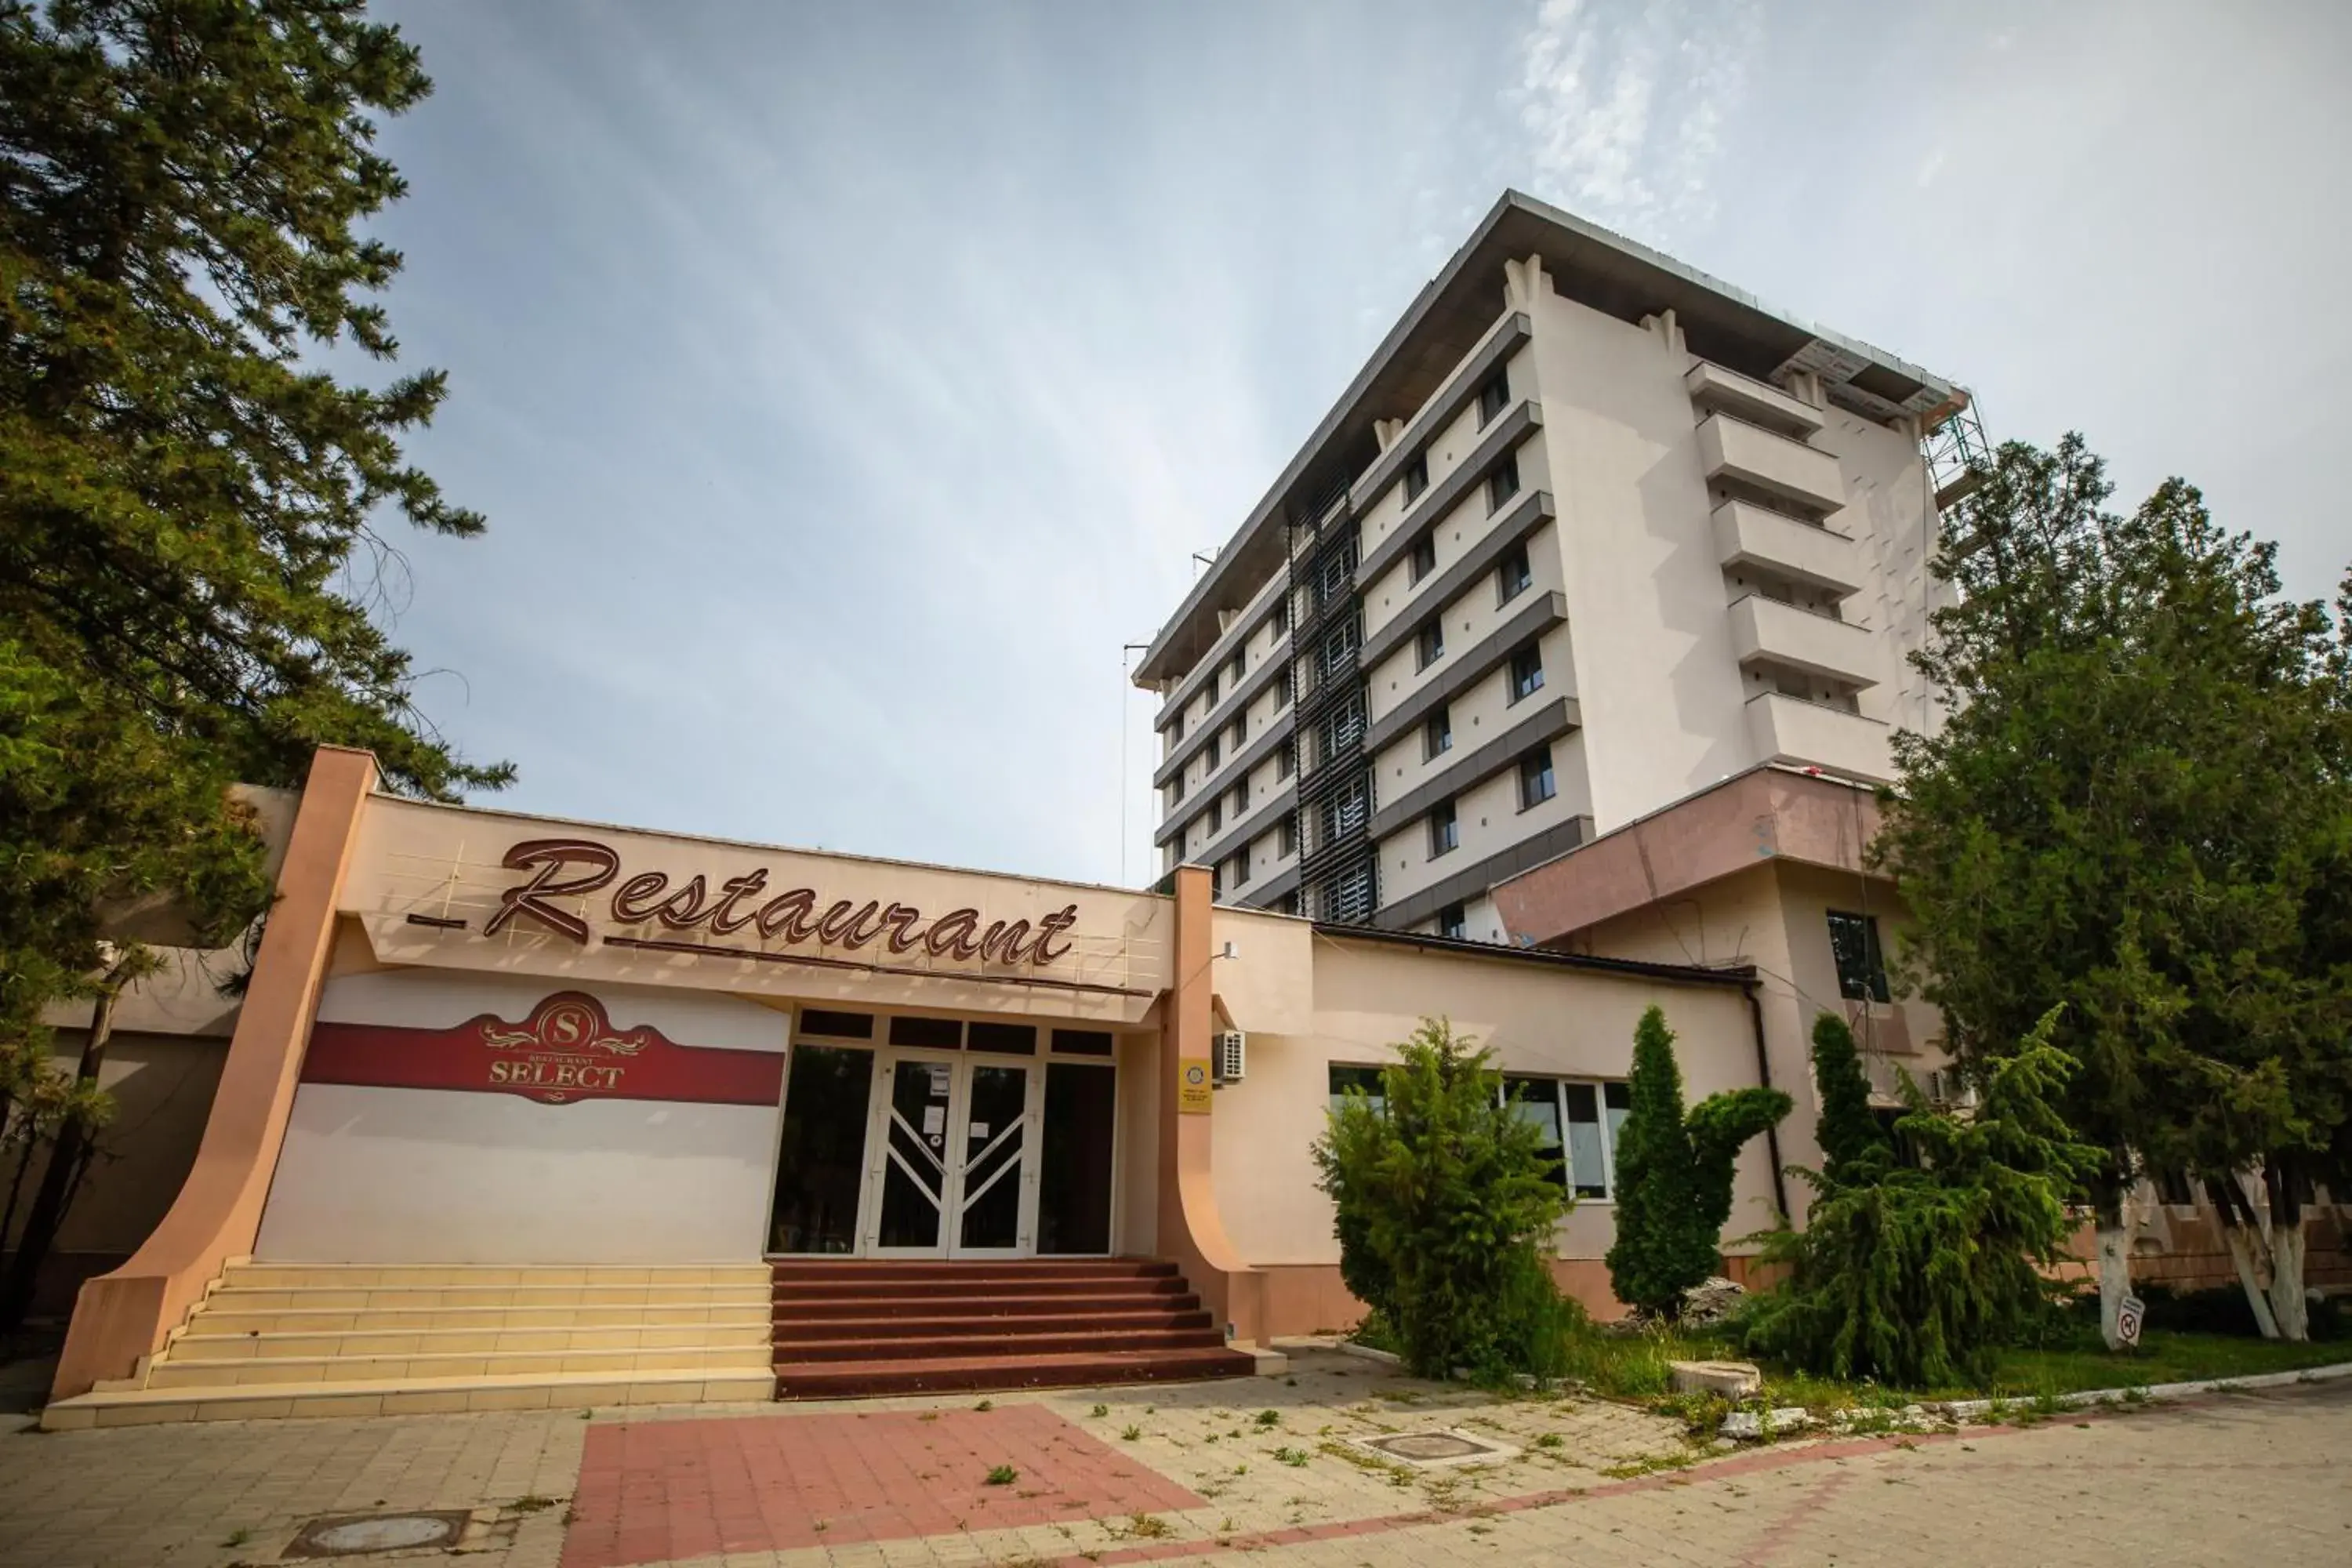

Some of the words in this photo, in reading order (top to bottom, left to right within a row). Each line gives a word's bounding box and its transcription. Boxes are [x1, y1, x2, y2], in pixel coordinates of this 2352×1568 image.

[483, 839, 1077, 966] Restaurant
[552, 1011, 582, 1044] S
[488, 1060, 625, 1090] SELECT
